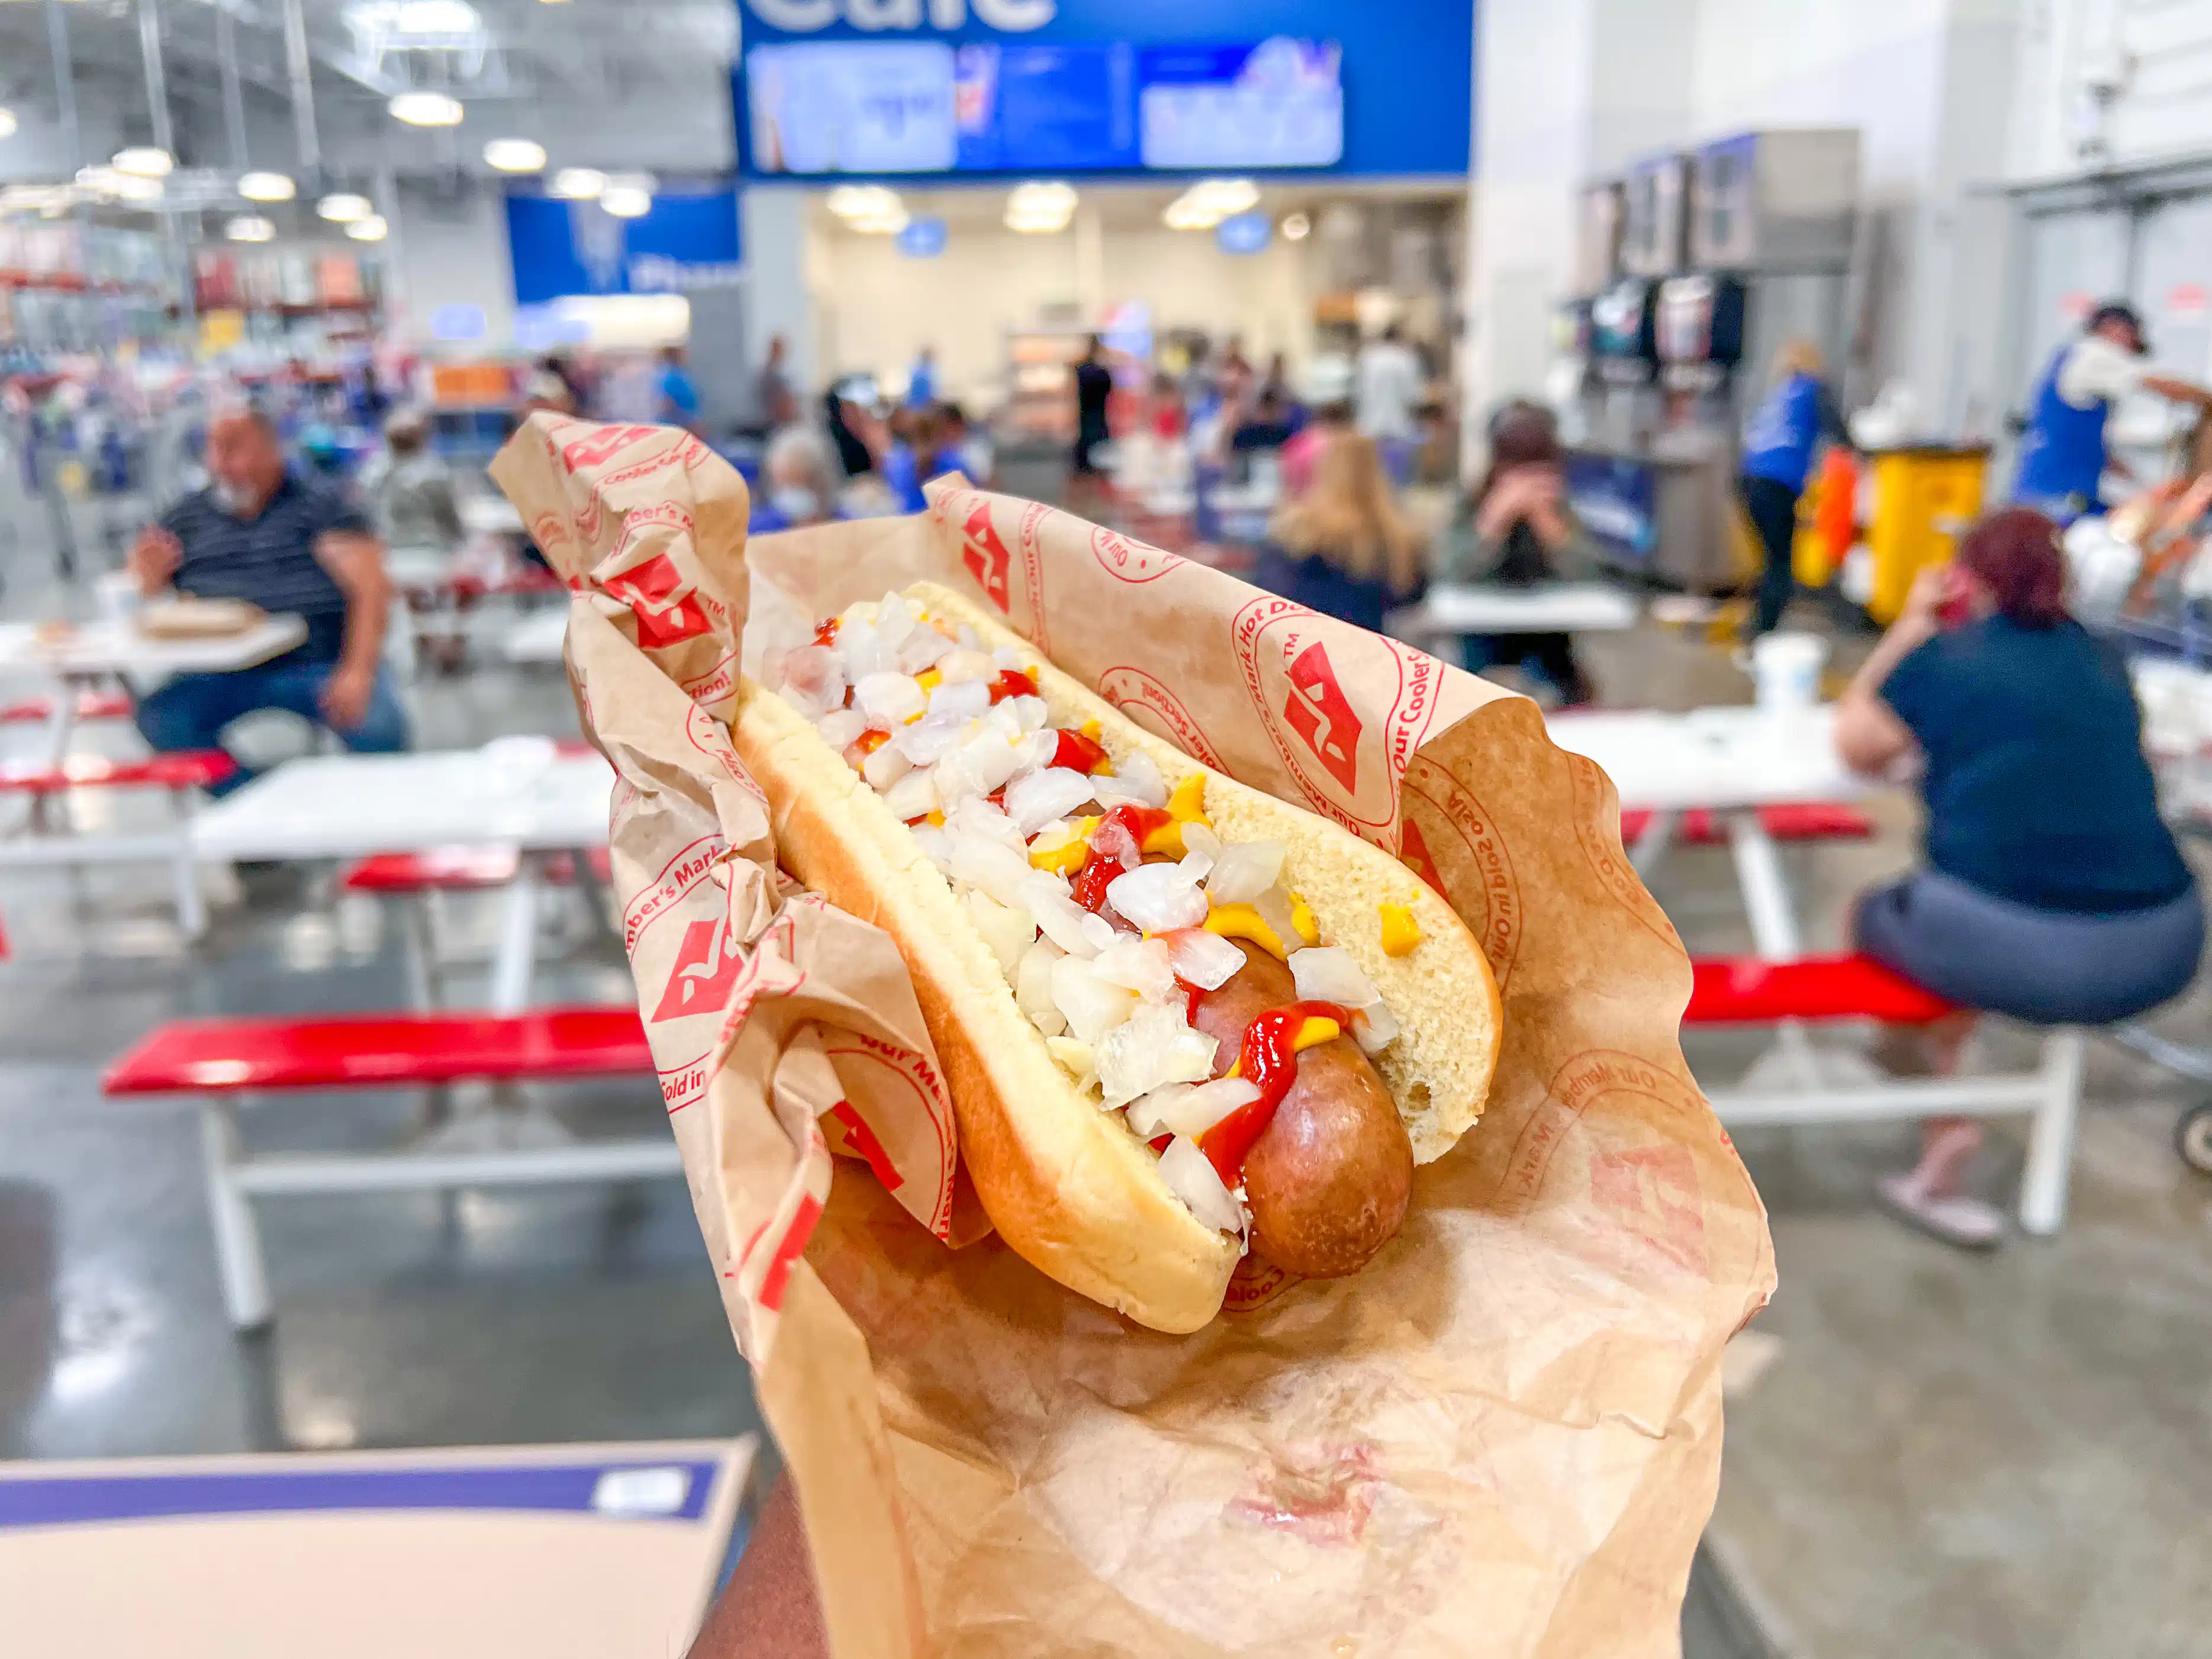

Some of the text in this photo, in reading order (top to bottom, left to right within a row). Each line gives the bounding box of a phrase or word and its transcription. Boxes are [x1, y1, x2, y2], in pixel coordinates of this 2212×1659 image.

[706, 598, 725, 617] TM
[1270, 601, 1311, 615] Do
[1238, 608, 1264, 649] Hot
[1284, 633, 1300, 659] TM
[688, 670, 732, 700] tion!
[1240, 648, 1263, 704] Mark
[1399, 662, 1430, 723] Cooler
[1189, 735, 1223, 774] oler
[1393, 726, 1410, 774] Our
[626, 885, 677, 951] mber's
